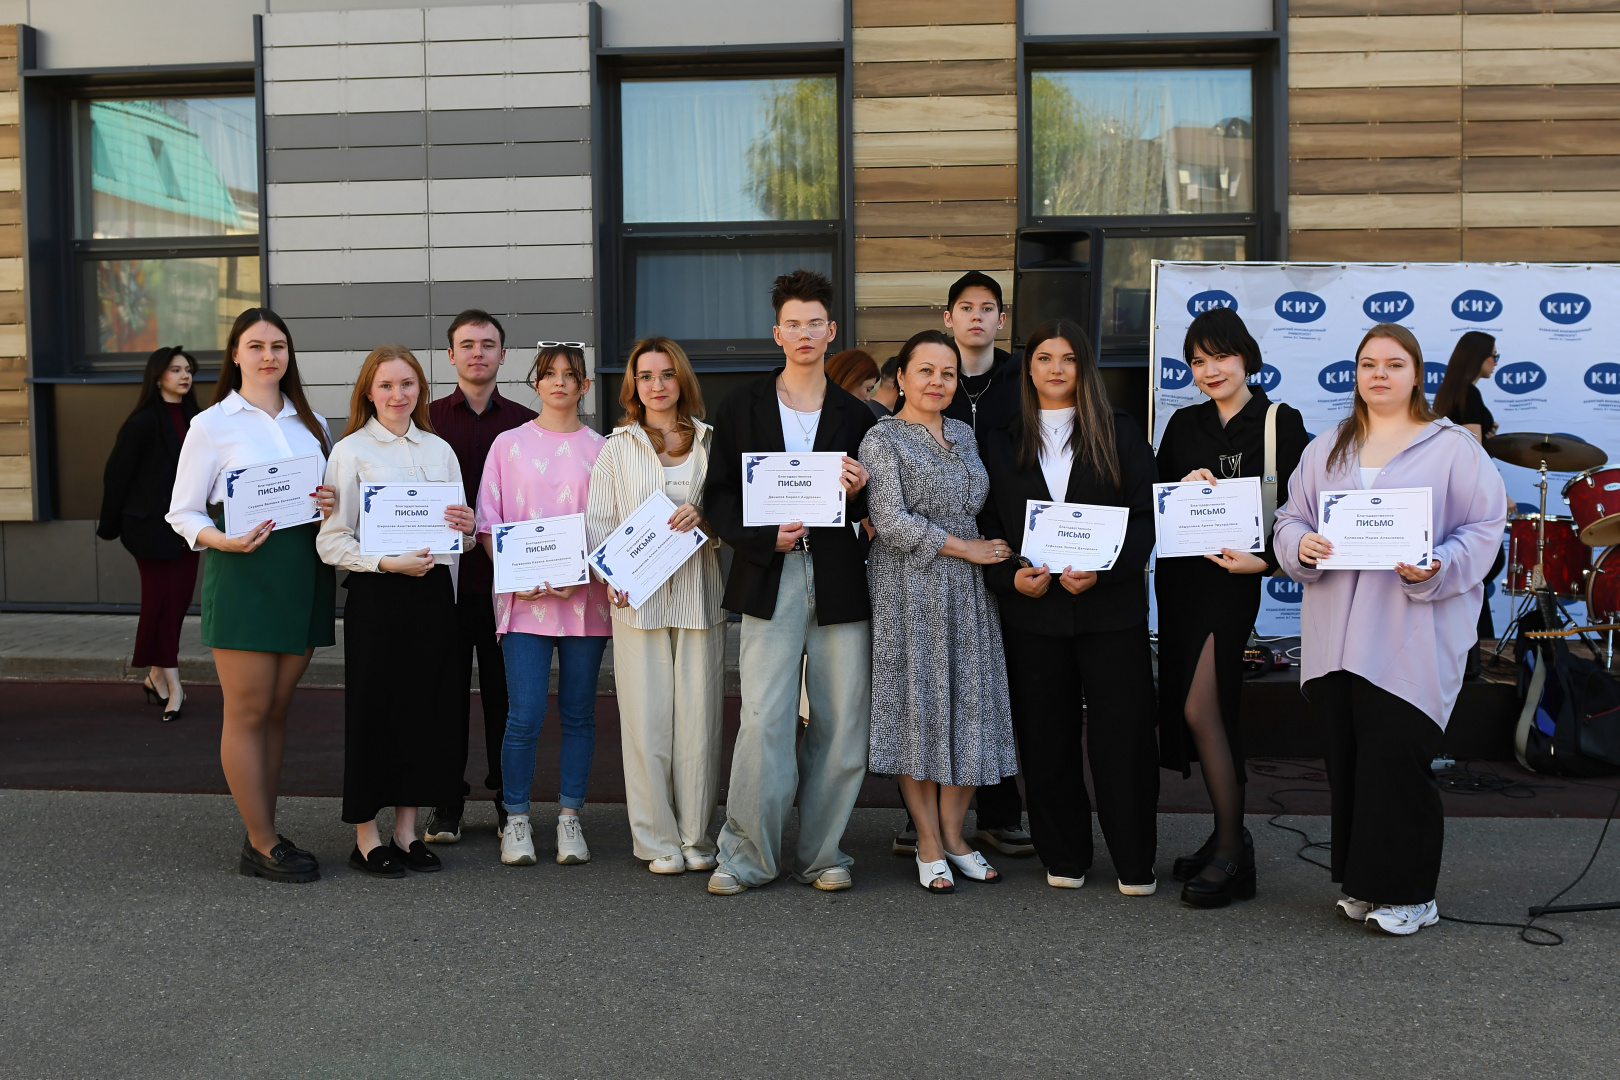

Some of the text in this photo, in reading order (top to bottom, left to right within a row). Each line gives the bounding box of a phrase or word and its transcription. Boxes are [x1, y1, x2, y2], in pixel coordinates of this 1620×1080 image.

[1282, 300, 1320, 314] КИУ
[1370, 299, 1408, 313] КИУ
[1458, 300, 1496, 312] КИУ
[1547, 302, 1584, 314] КИУ
[1162, 368, 1187, 381] ИУ
[1250, 372, 1274, 384] ИУ
[1326, 371, 1356, 384] КИ
[1502, 371, 1540, 384] КИУ
[1592, 372, 1620, 384] КИ
[258, 484, 290, 496] ПИСЬМО
[1190, 508, 1226, 516] ПИСЬМО
[1057, 530, 1090, 539] ПИСЬМО
[526, 544, 556, 553] ПИСЬМО
[630, 532, 656, 558] ПИСЬМО
[1274, 582, 1304, 593] КИ
